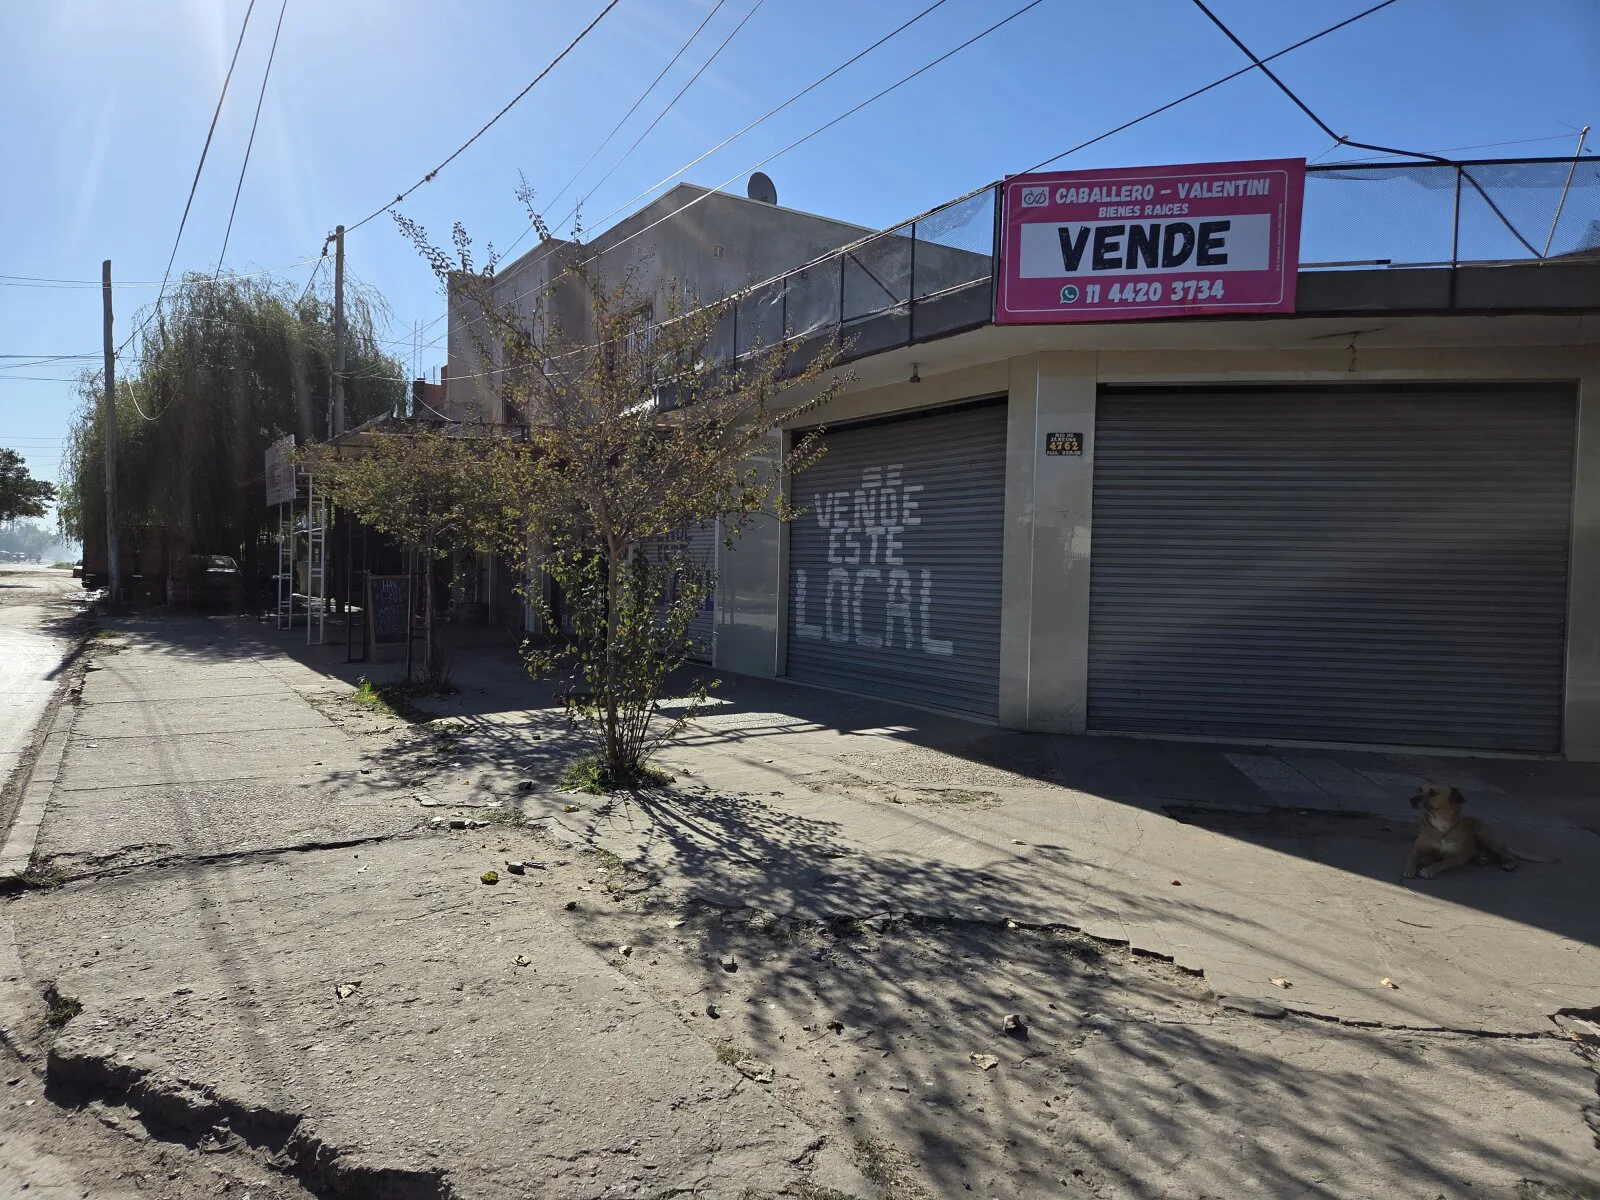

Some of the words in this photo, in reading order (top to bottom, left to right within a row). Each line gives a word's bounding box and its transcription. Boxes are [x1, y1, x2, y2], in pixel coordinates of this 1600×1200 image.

[1055, 184, 1155, 204] CABALLERO
[1177, 178, 1270, 199] VALENTINI
[1098, 205, 1141, 218] BIENES
[1144, 203, 1189, 216] RAICES
[1058, 220, 1231, 272] VENDE
[1086, 284, 1100, 304] 11
[1108, 282, 1163, 303] 4420
[1171, 279, 1225, 301] 3734
[814, 485, 924, 528] VENDE
[827, 526, 905, 565] ESTE
[795, 566, 954, 655] LOCAL
